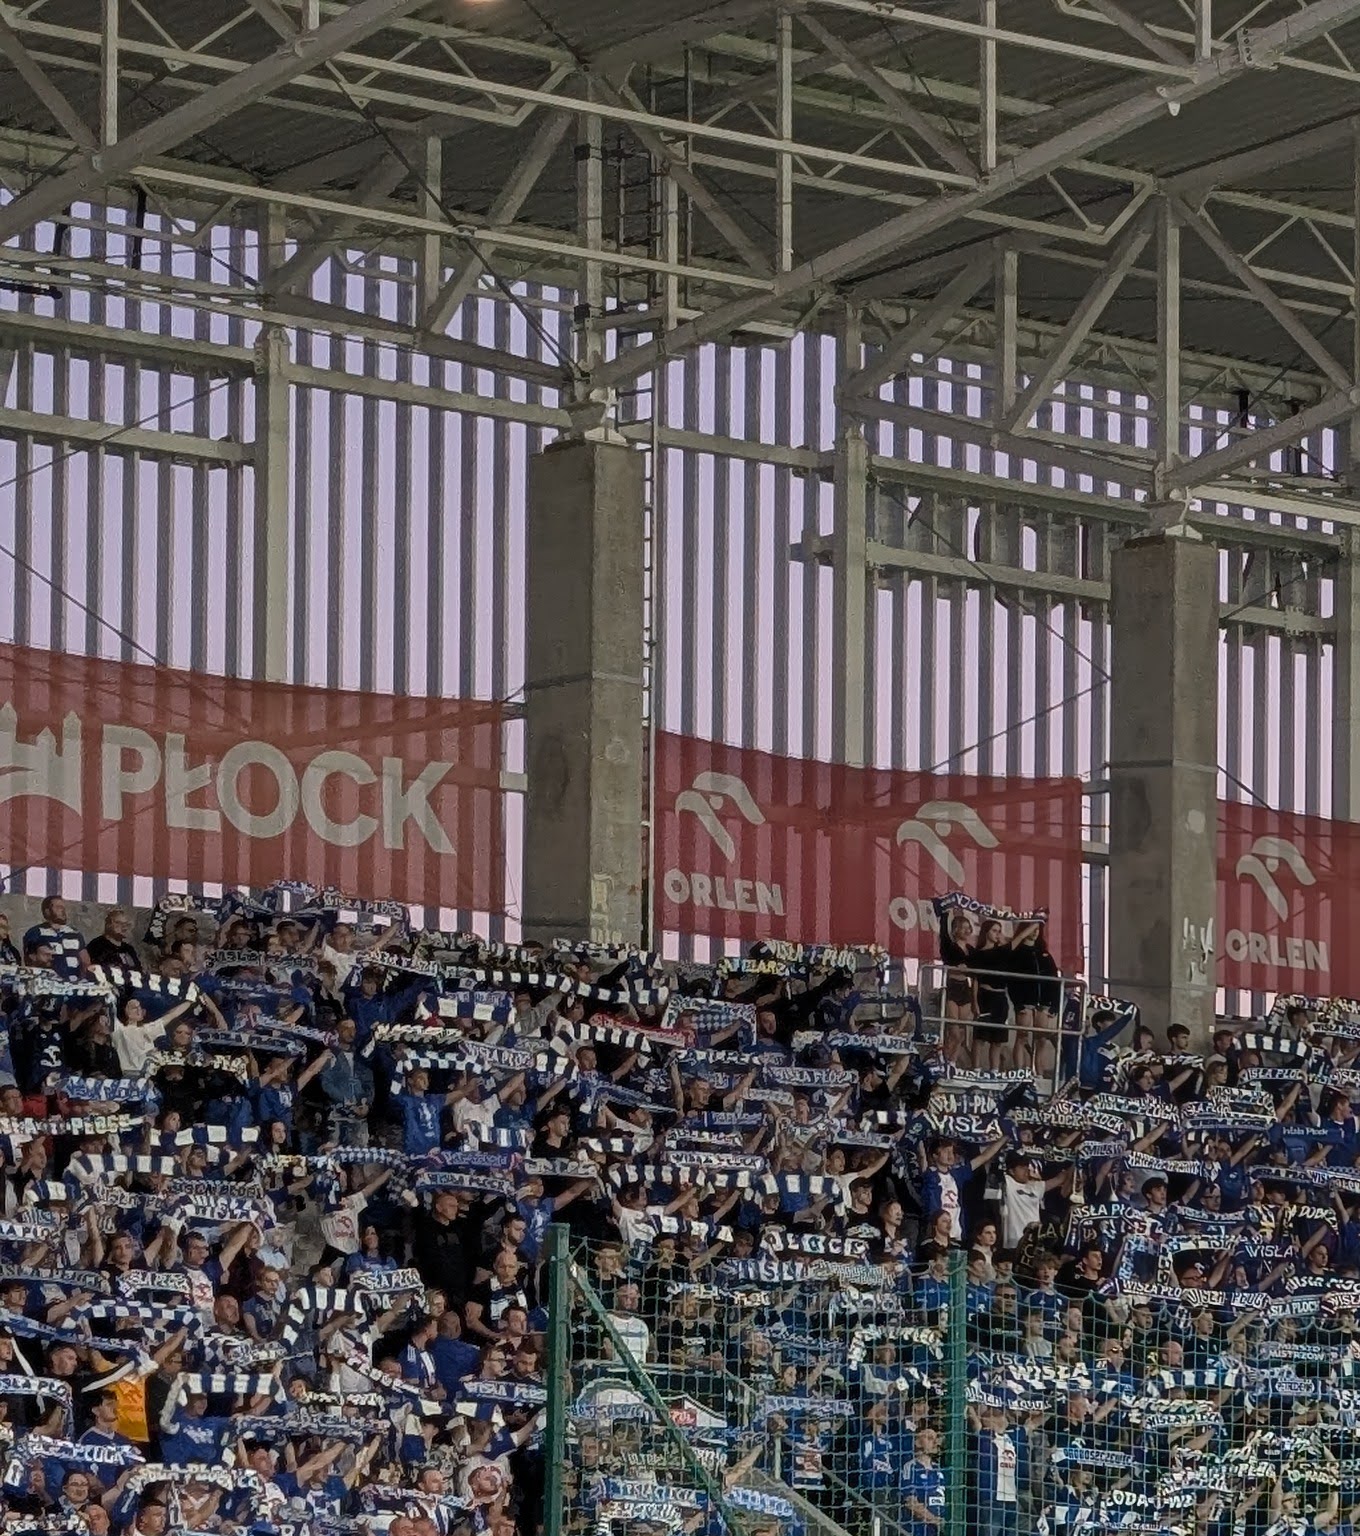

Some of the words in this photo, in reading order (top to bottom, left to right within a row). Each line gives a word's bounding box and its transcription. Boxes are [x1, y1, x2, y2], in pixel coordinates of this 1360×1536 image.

[101, 724, 457, 856] PŁOCK
[664, 867, 786, 918] ORLEN
[1226, 928, 1330, 974] ORLEN
[925, 1112, 1003, 1136] WISŁA
[1246, 1245, 1294, 1258] WISŁA
[1009, 1361, 1087, 1381] WISŁA
